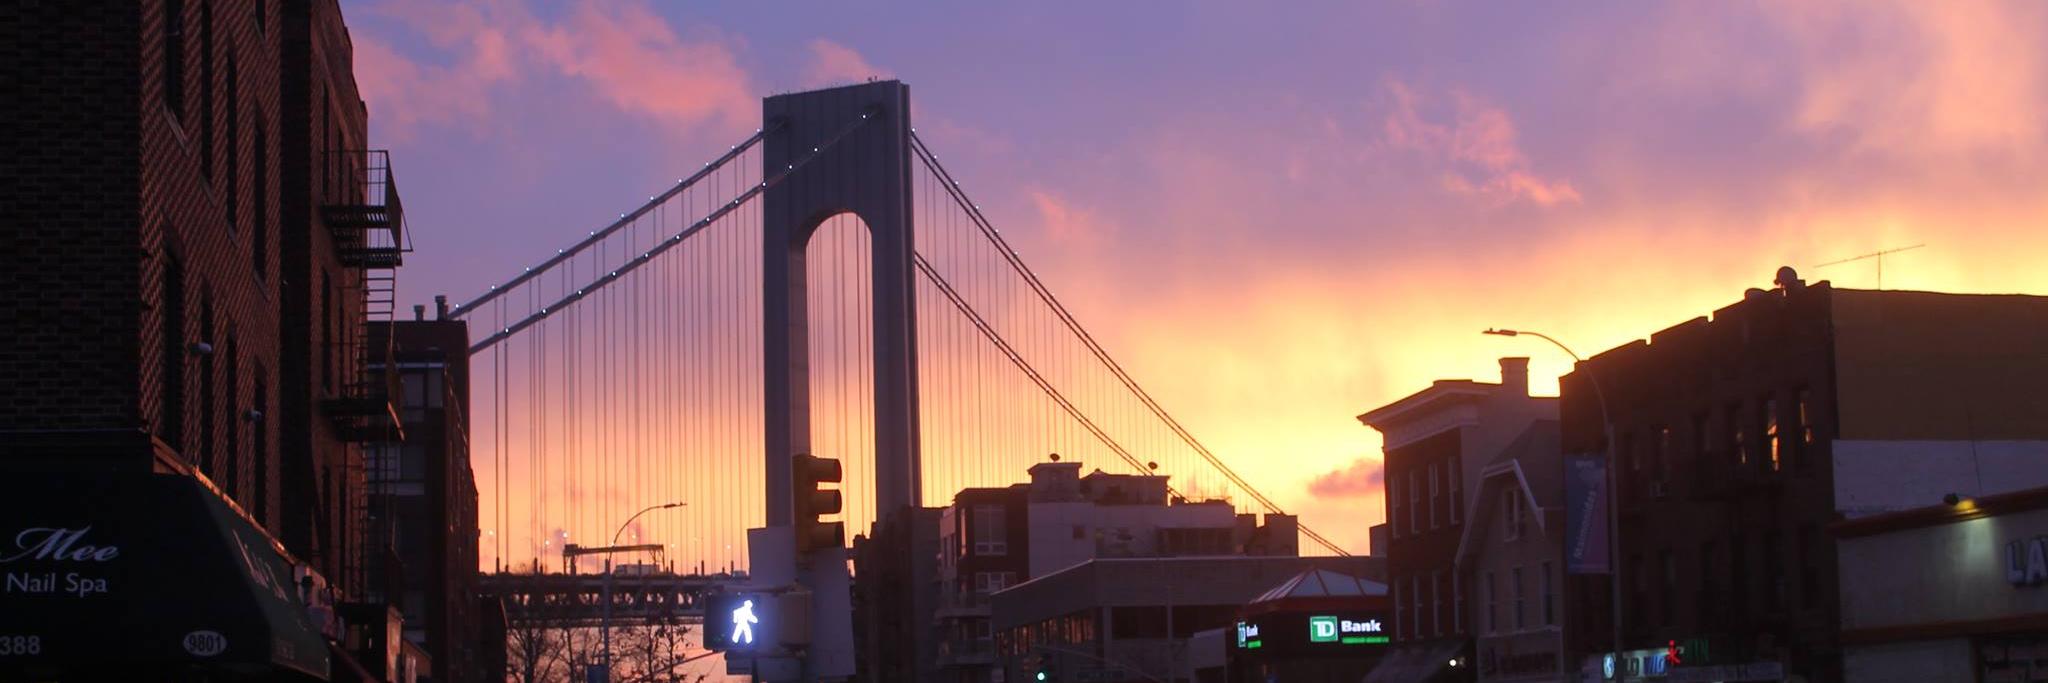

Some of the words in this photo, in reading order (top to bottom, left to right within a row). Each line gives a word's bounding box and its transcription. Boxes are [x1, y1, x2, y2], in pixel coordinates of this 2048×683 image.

[0, 523, 120, 562] Mee
[2007, 538, 2048, 584] LA
[7, 573, 55, 592] Nail
[65, 573, 108, 598] Spa
[1313, 620, 1335, 637] TD
[1341, 619, 1381, 632] Bank
[189, 634, 222, 652] 9801
